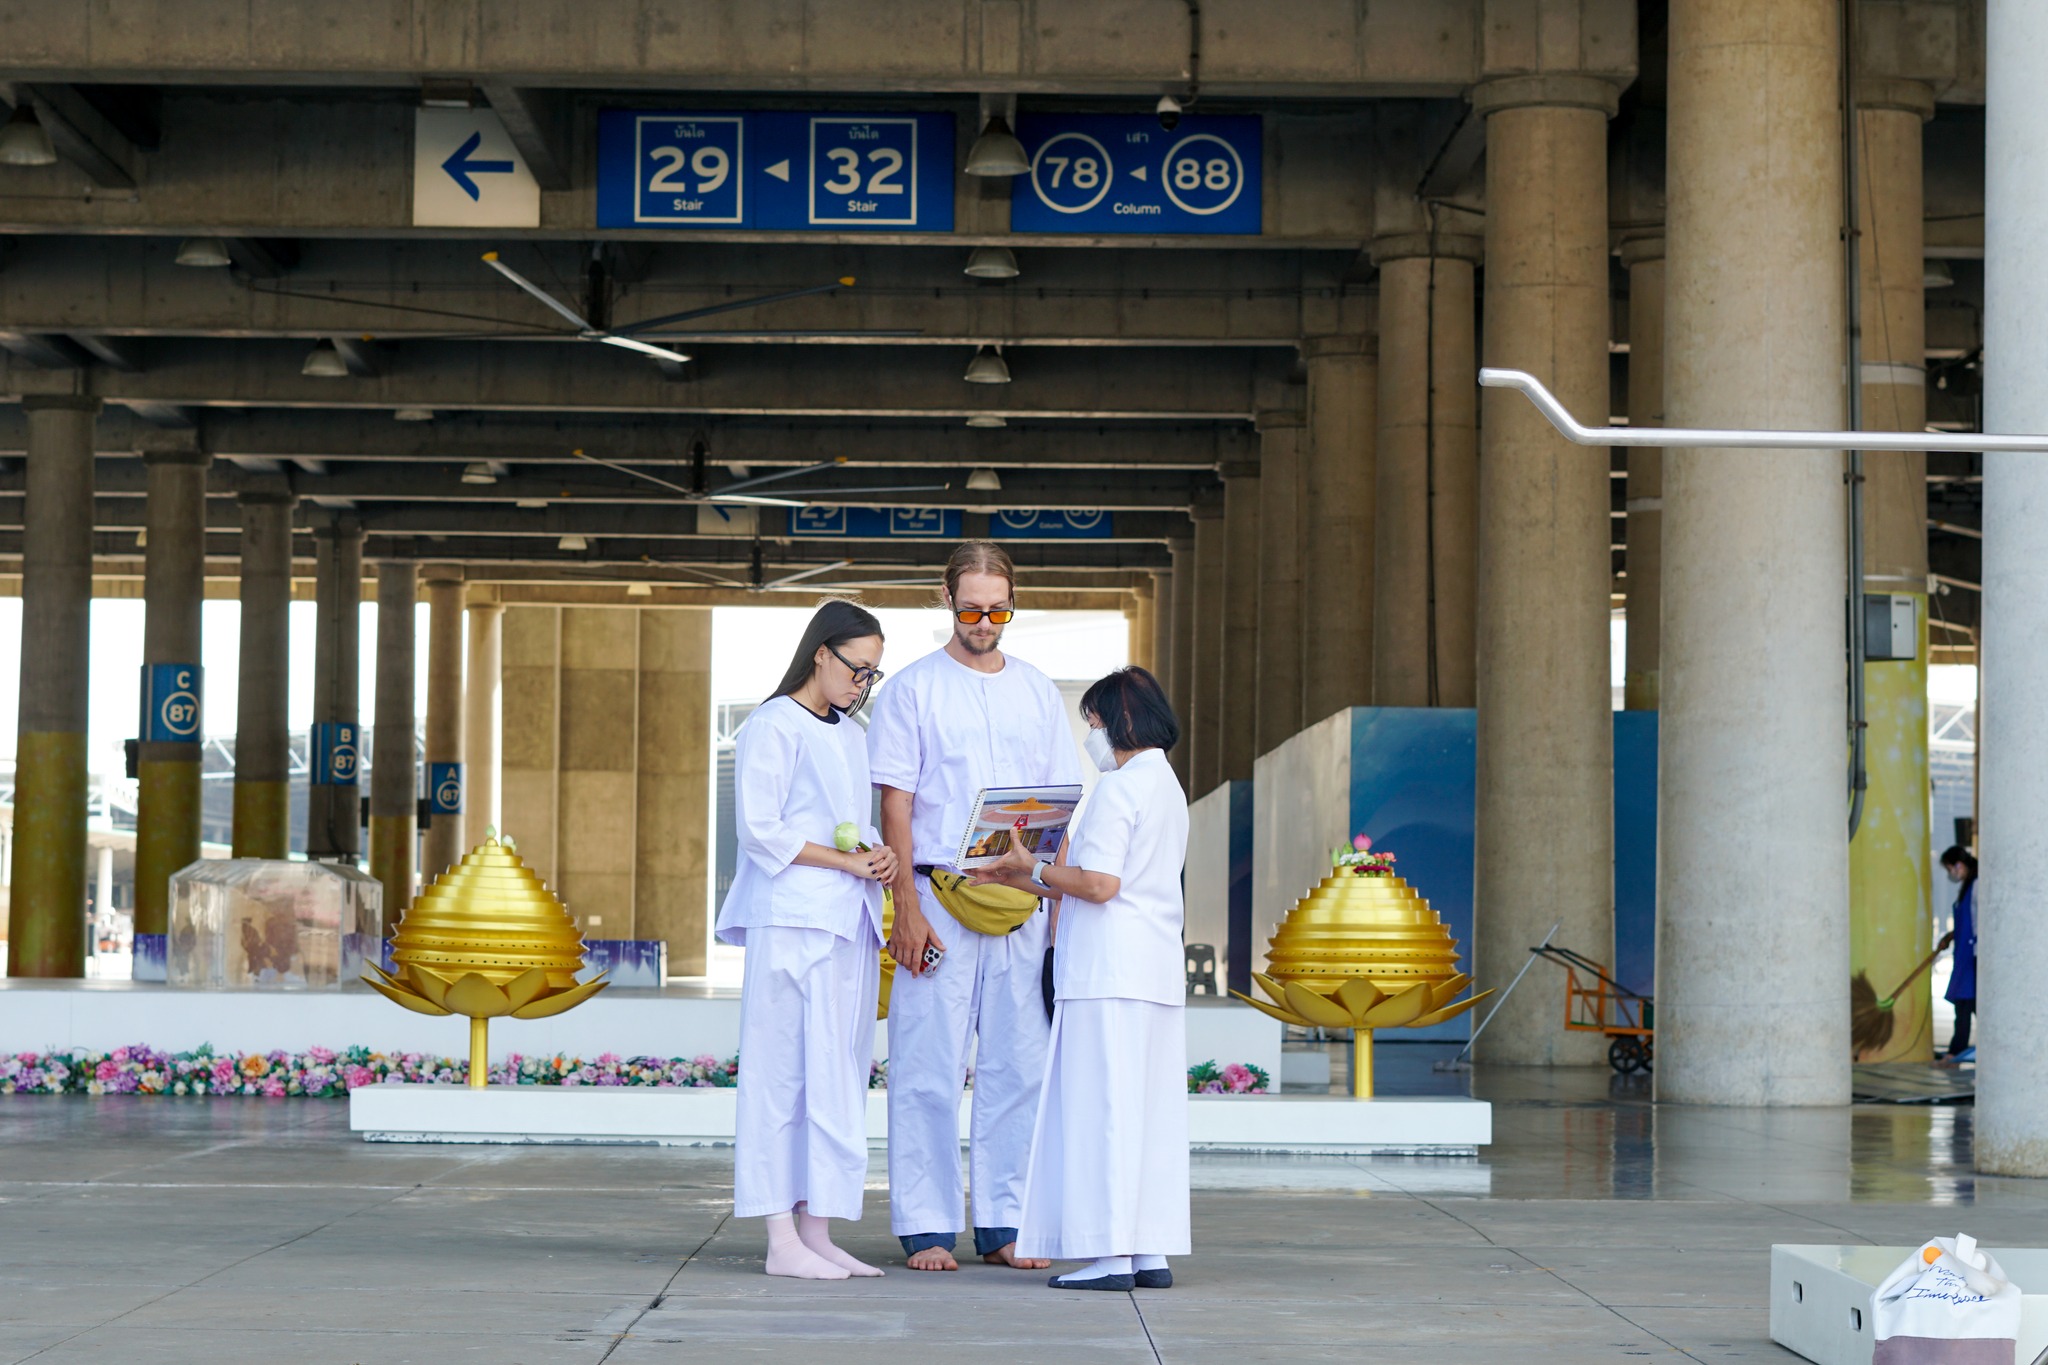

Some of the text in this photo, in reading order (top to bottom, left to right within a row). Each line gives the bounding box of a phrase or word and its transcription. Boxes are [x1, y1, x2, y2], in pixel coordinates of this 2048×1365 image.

[648, 146, 730, 194] 29
[823, 147, 904, 195] 32
[1045, 157, 1099, 189] 78
[1174, 158, 1231, 191] 88
[673, 198, 704, 212] Stair
[847, 199, 879, 213] Stair
[1113, 202, 1162, 215] Column
[176, 671, 191, 689] C
[168, 704, 195, 723] 87
[340, 728, 352, 743] B
[335, 755, 355, 770] 87
[446, 767, 458, 780] A
[441, 787, 460, 802] 87
